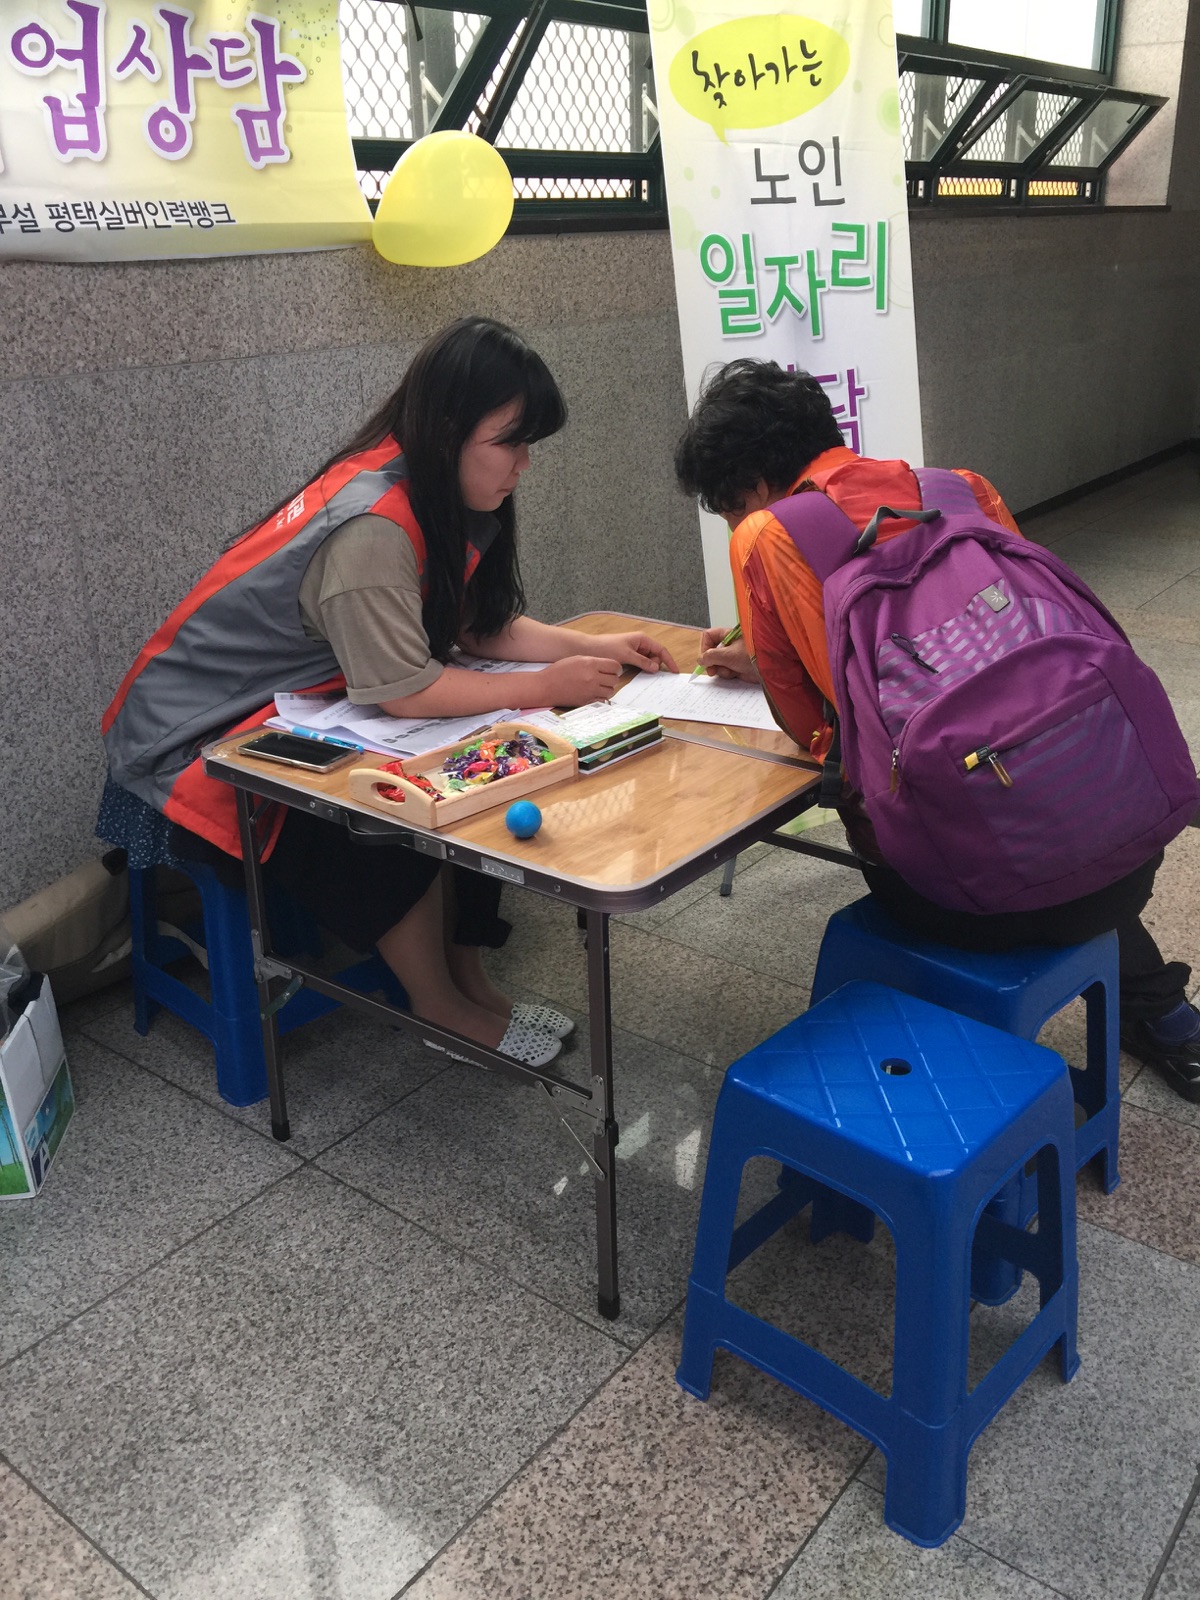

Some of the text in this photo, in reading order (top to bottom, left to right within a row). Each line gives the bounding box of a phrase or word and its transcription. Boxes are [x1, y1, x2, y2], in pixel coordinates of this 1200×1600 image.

[691, 39, 823, 109] 찾아가는
[750, 135, 846, 207] 노인
[45, 200, 236, 233] 평택실버인력뱅크
[699, 220, 887, 337] 일자리
